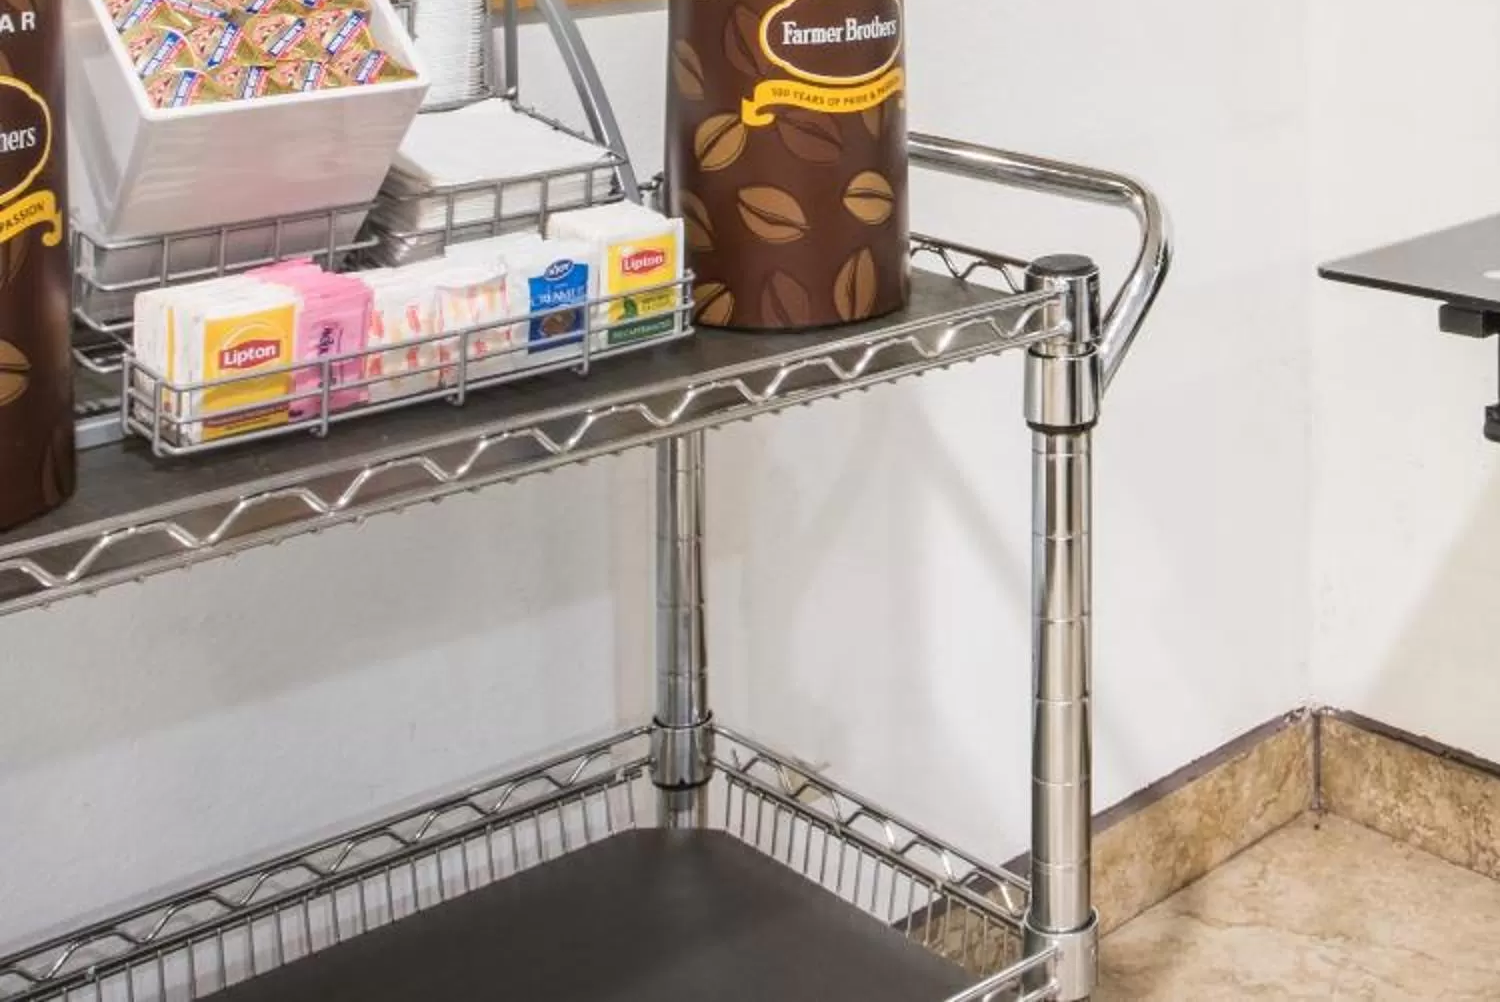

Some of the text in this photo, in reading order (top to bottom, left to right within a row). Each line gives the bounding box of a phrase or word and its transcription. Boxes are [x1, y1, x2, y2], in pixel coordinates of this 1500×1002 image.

[782, 15, 897, 45] Farmer Brothers
[623, 254, 663, 272] Lipton
[223, 344, 277, 367] Lipton
